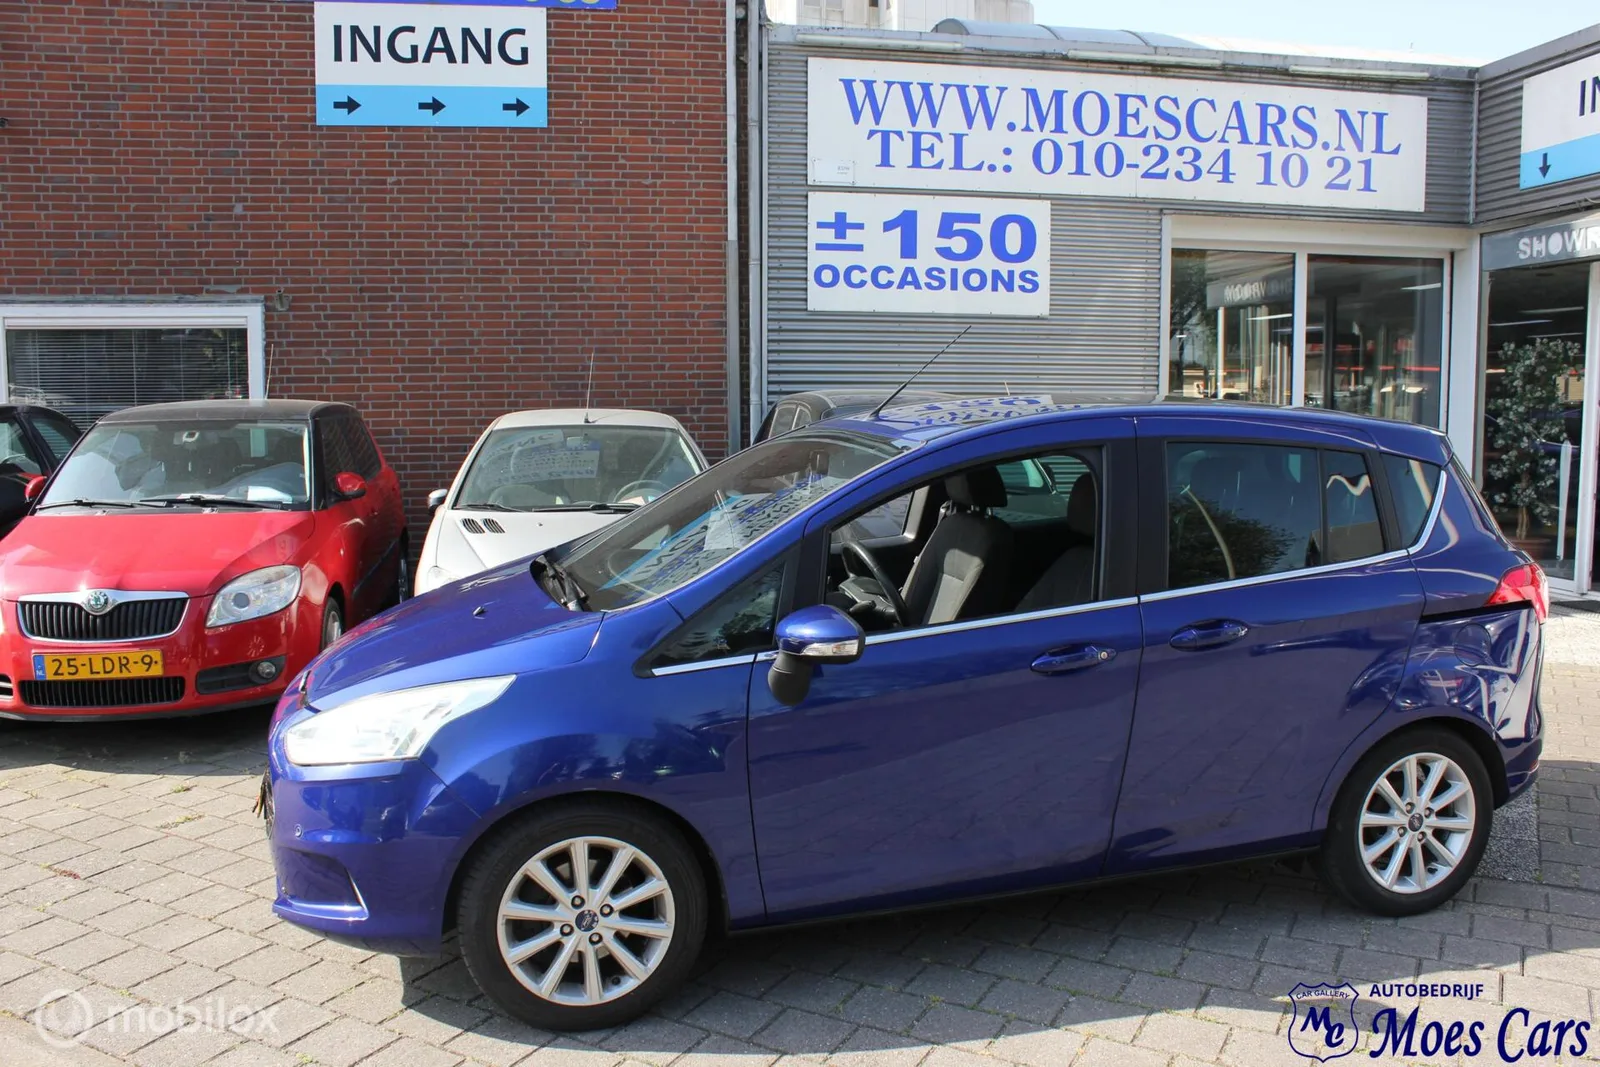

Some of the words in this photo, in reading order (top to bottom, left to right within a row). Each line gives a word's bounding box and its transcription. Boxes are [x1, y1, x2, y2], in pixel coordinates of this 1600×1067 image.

[333, 24, 529, 66] INGANG
[838, 77, 1402, 156] WWW.MOESCARS.NL
[866, 128, 1013, 174] TEL.:
[1032, 138, 1237, 184] 010-234
[1256, 150, 1309, 188] 10
[1324, 156, 1378, 193] 21
[813, 263, 1040, 294] OCCASIONS
[51, 654, 154, 677] 25-LDR-9
